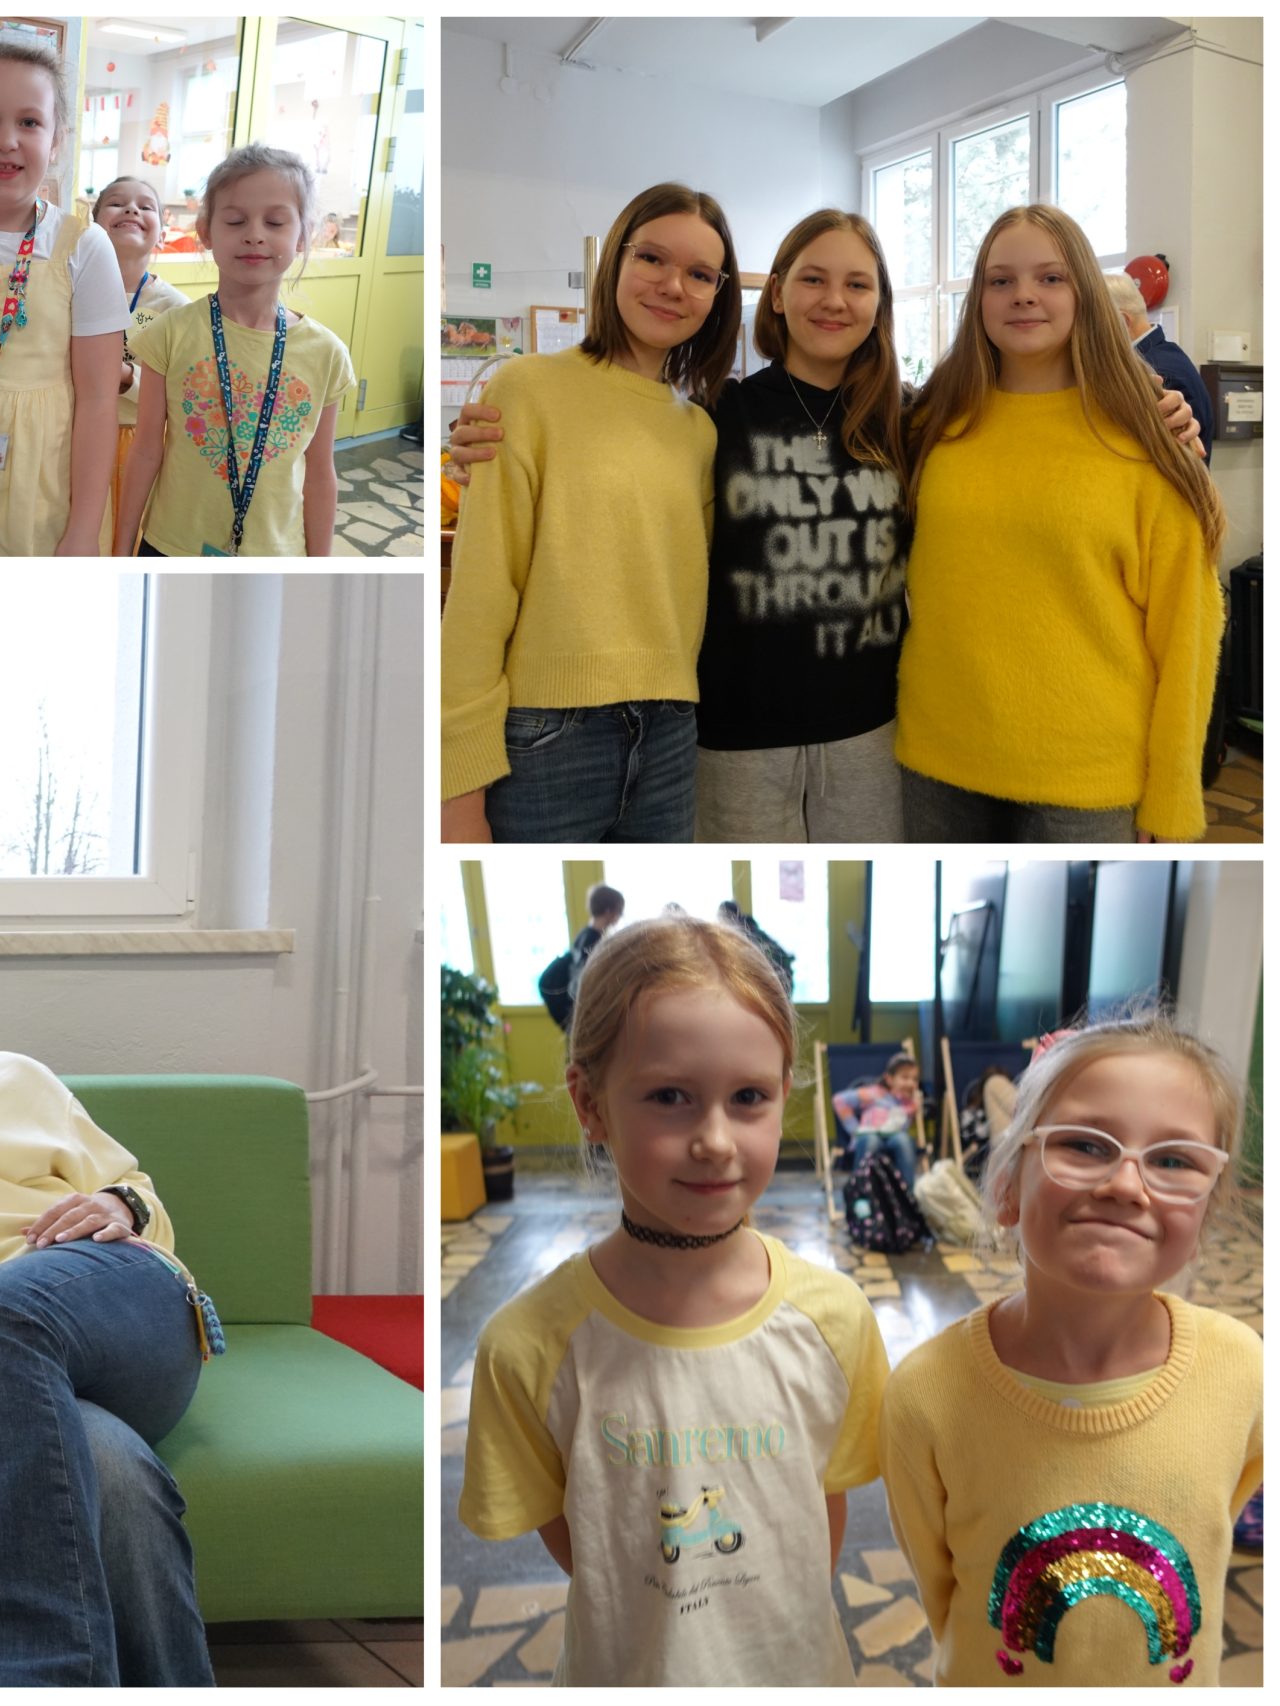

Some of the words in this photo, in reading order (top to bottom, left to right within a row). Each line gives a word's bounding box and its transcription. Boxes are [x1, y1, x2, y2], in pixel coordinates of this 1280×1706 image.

[749, 434, 832, 474] THE
[726, 474, 839, 519] ONLY
[765, 518, 858, 570] OUT
[865, 516, 896, 565] IS
[816, 621, 850, 658] IT
[600, 1412, 786, 1468] Sanremo
[680, 1596, 709, 1615] ITALY
